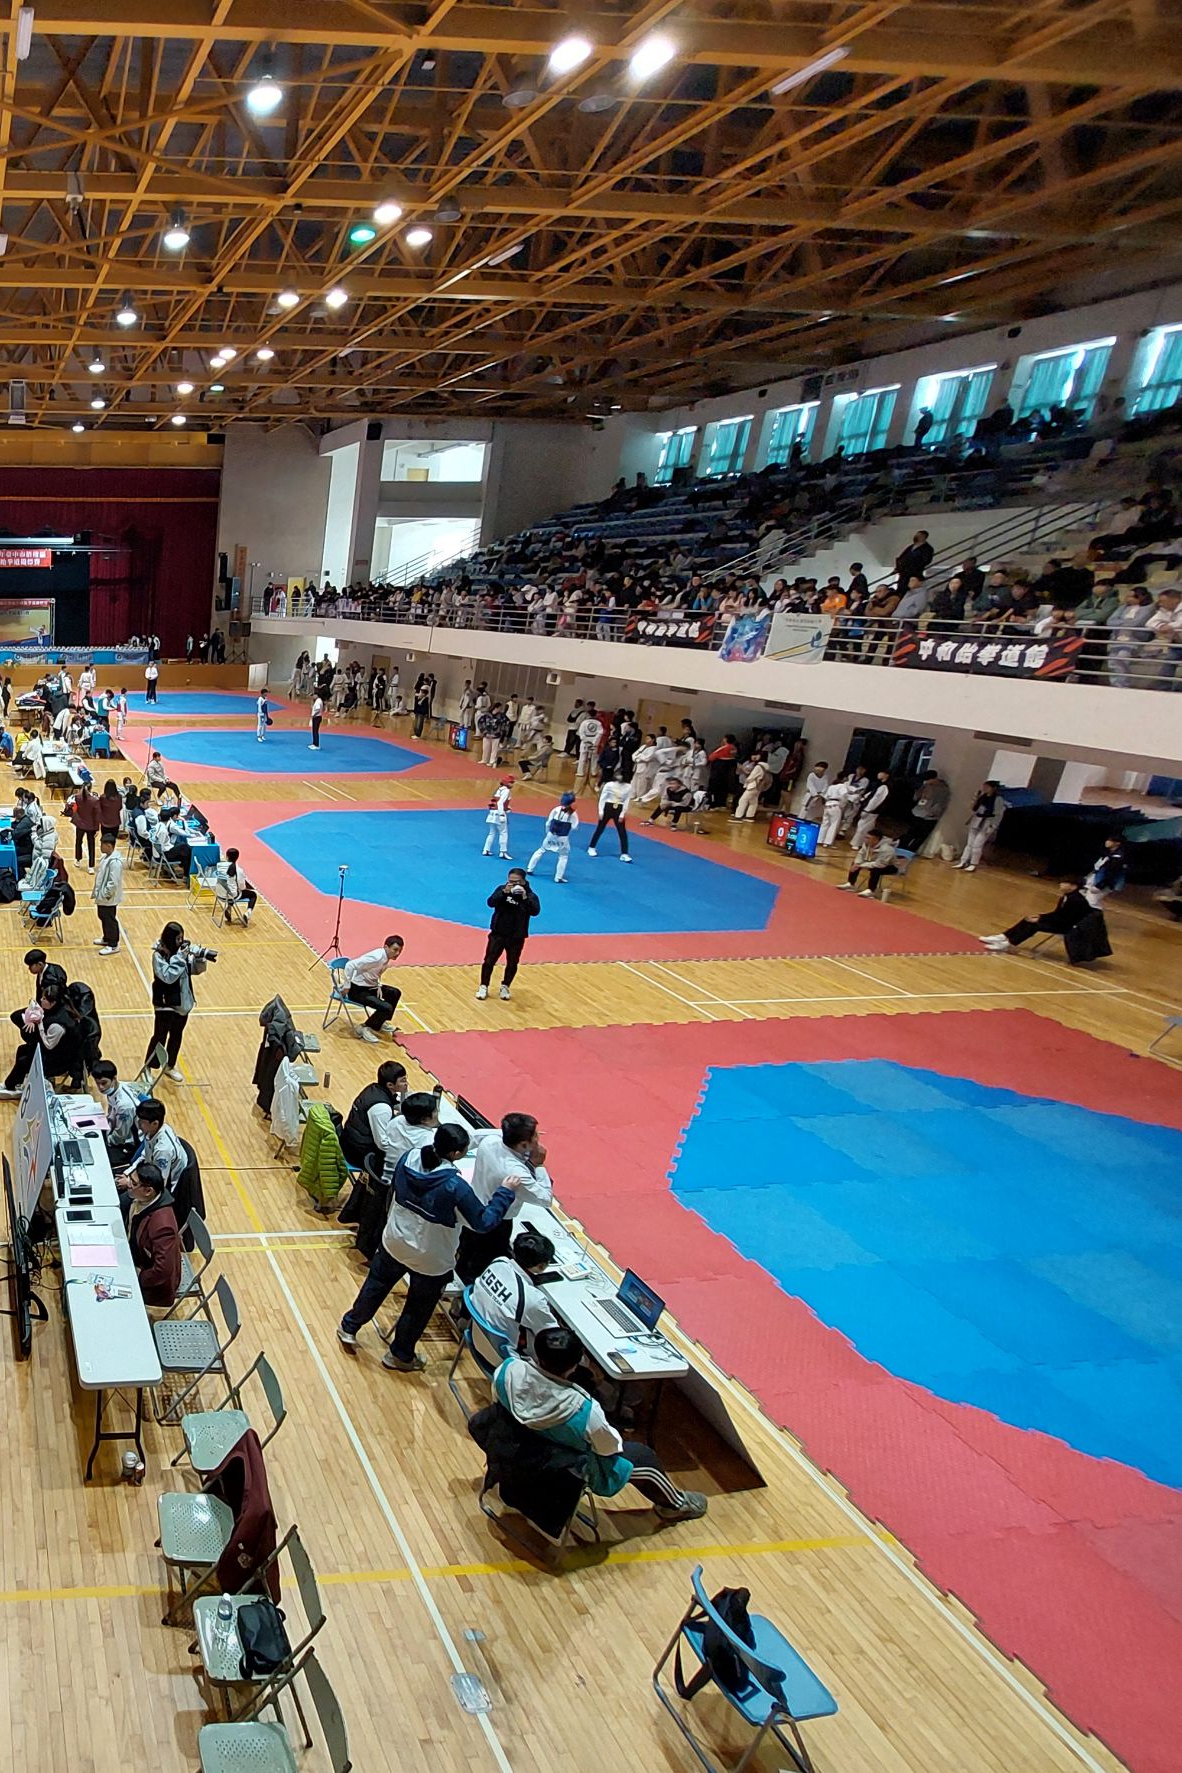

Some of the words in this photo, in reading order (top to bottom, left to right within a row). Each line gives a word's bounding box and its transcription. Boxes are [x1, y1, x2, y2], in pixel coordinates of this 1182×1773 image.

[919, 639, 1048, 668] 中和跆拳道館
[481, 1268, 513, 1303] CGSH
